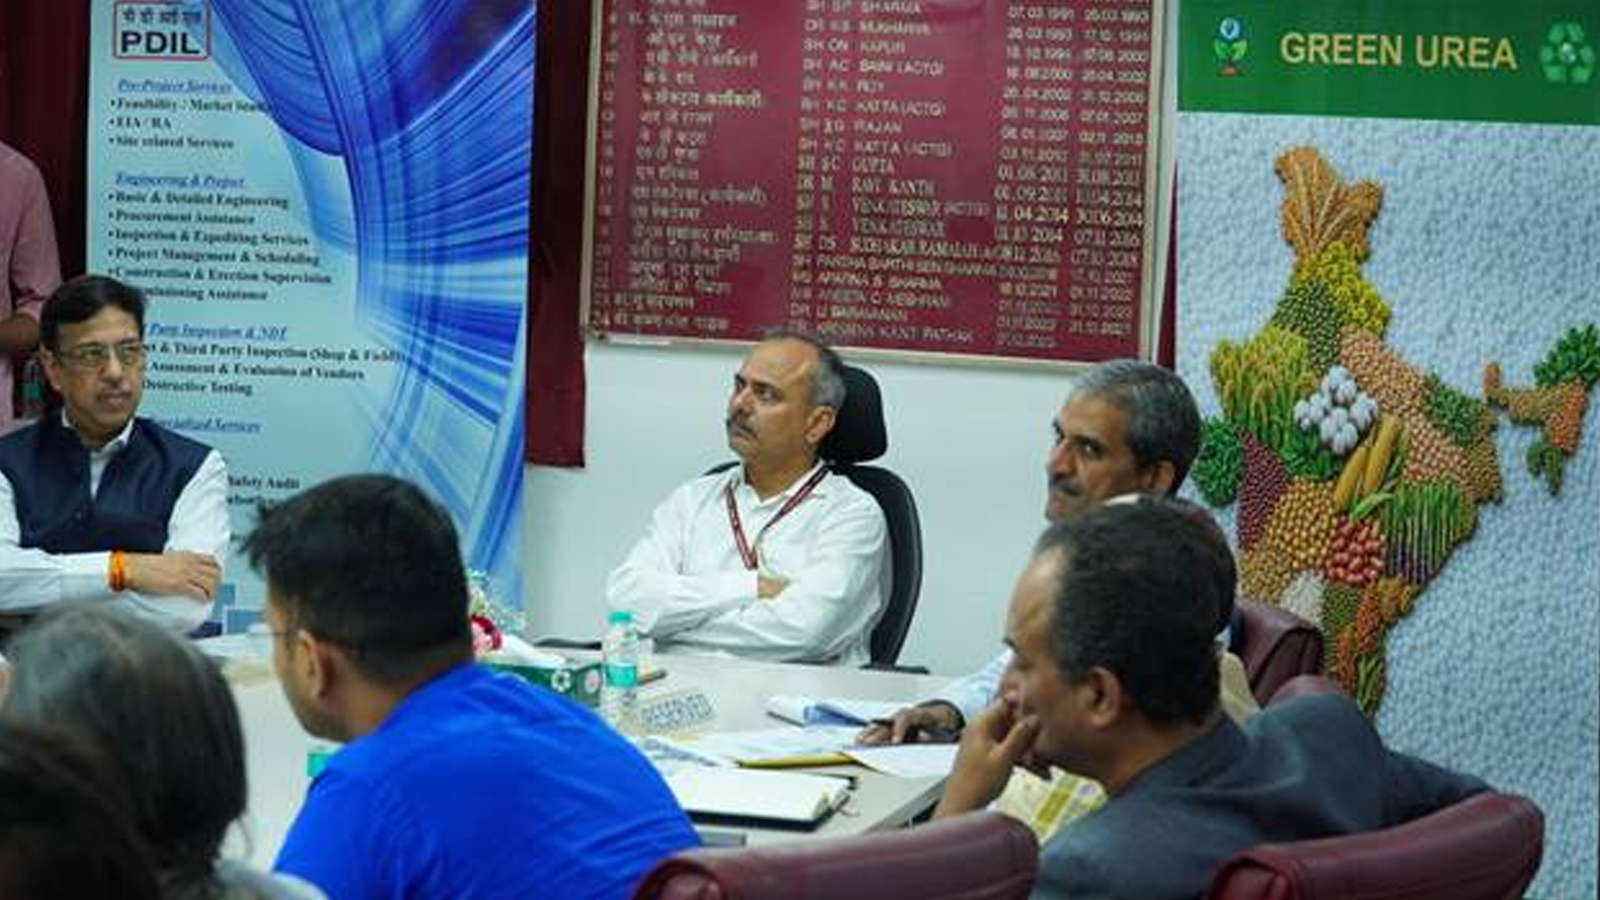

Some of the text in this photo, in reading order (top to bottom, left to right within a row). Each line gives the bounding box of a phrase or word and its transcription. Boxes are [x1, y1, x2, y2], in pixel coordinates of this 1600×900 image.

[121, 31, 200, 54] PDIL
[1280, 32, 1518, 69] GREEN UREA
[190, 99, 232, 111] Market
[116, 136, 234, 149] Site related Services
[116, 190, 146, 203] Basic
[166, 191, 213, 205] Detailed
[216, 193, 288, 209] Engineering
[115, 210, 255, 224] Procurement Assistance
[115, 229, 177, 244] Inspection
[193, 231, 258, 246] Expediting
[261, 234, 309, 246] Services
[115, 247, 160, 262] Project
[162, 249, 236, 265] Management
[254, 252, 320, 267] Scheduling
[115, 266, 191, 279] Construction
[208, 269, 259, 281] Erection
[262, 272, 331, 286] Supervision
[208, 288, 268, 300] Assistance
[174, 344, 208, 355] Third
[211, 345, 242, 359] Party
[247, 345, 307, 360] Inspection
[151, 362, 215, 375] Assessment
[234, 364, 297, 377] Evaluation
[315, 367, 365, 380] Vendors
[211, 383, 253, 396] Testing
